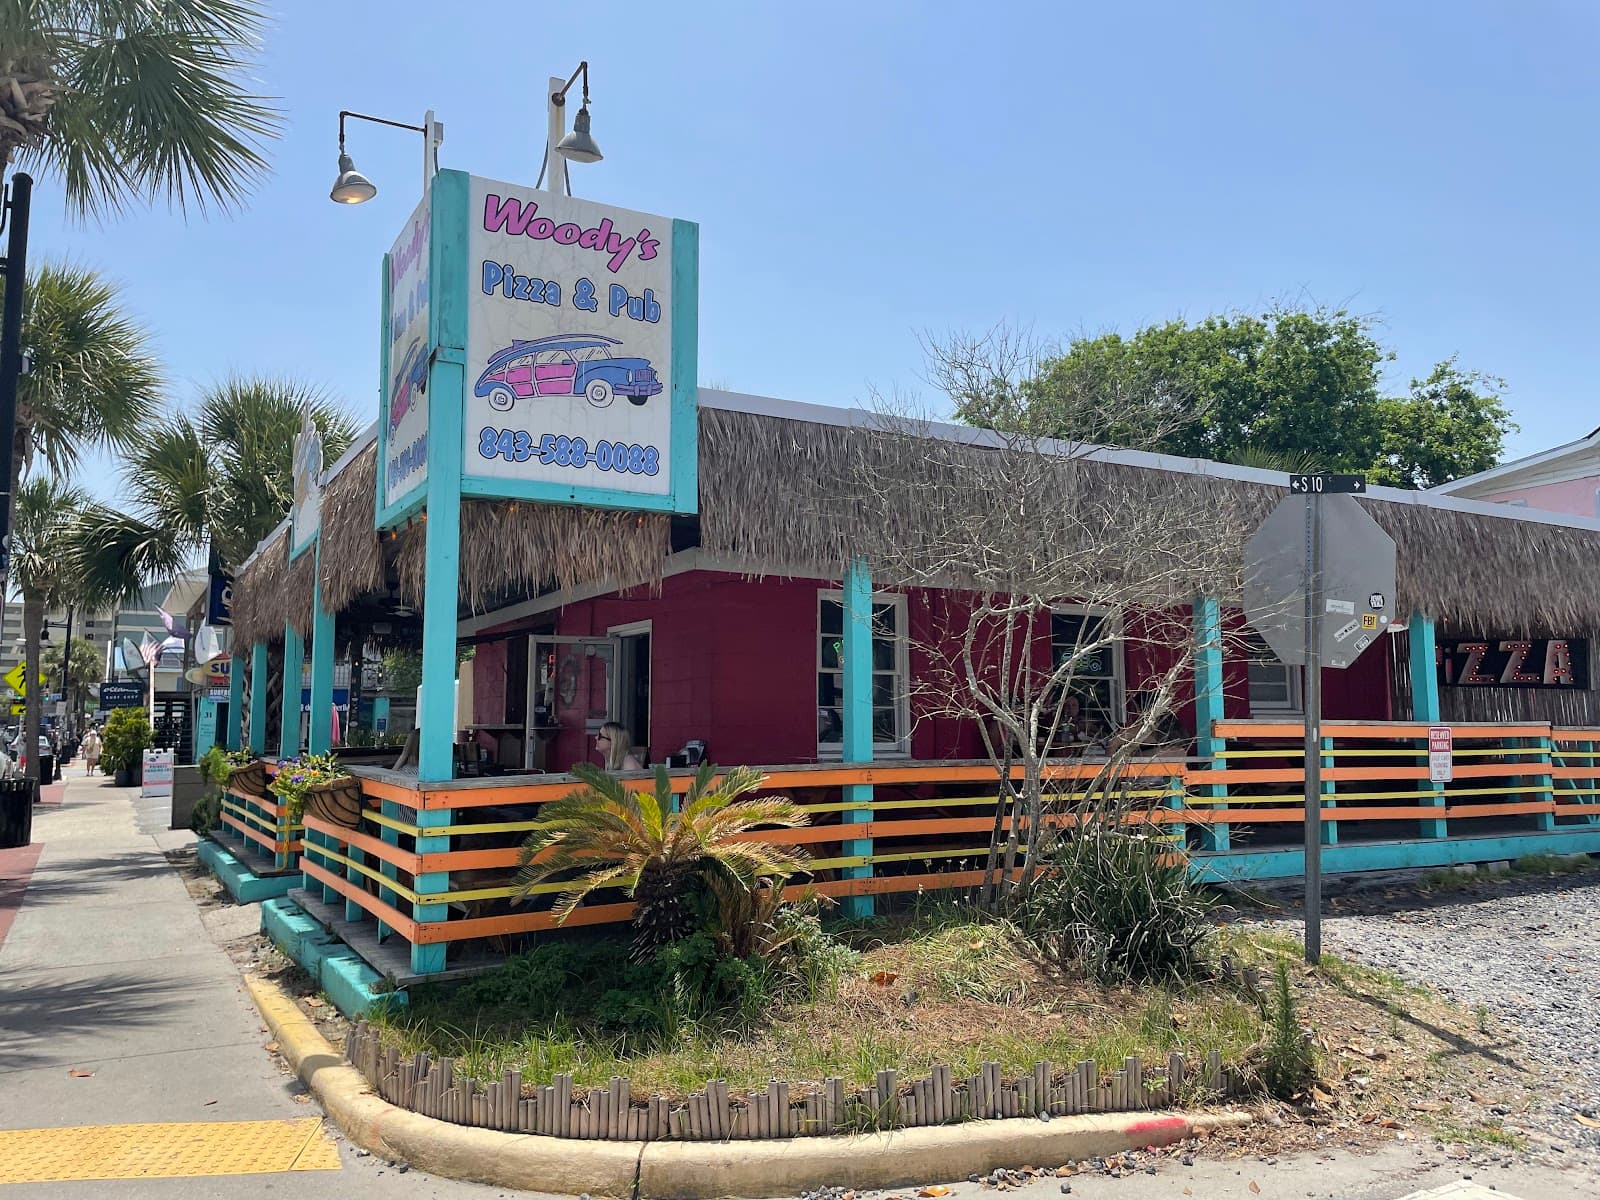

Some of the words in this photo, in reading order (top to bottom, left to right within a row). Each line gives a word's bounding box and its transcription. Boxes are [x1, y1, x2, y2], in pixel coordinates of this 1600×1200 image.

[483, 194, 661, 273] Woody's
[482, 260, 561, 306] Pizza
[572, 278, 597, 312] &
[608, 284, 661, 323] Pub
[479, 426, 659, 476] 843-588-0088
[1301, 476, 1308, 492] S
[1312, 476, 1323, 492] 10
[1431, 741, 1450, 750] PARKING
